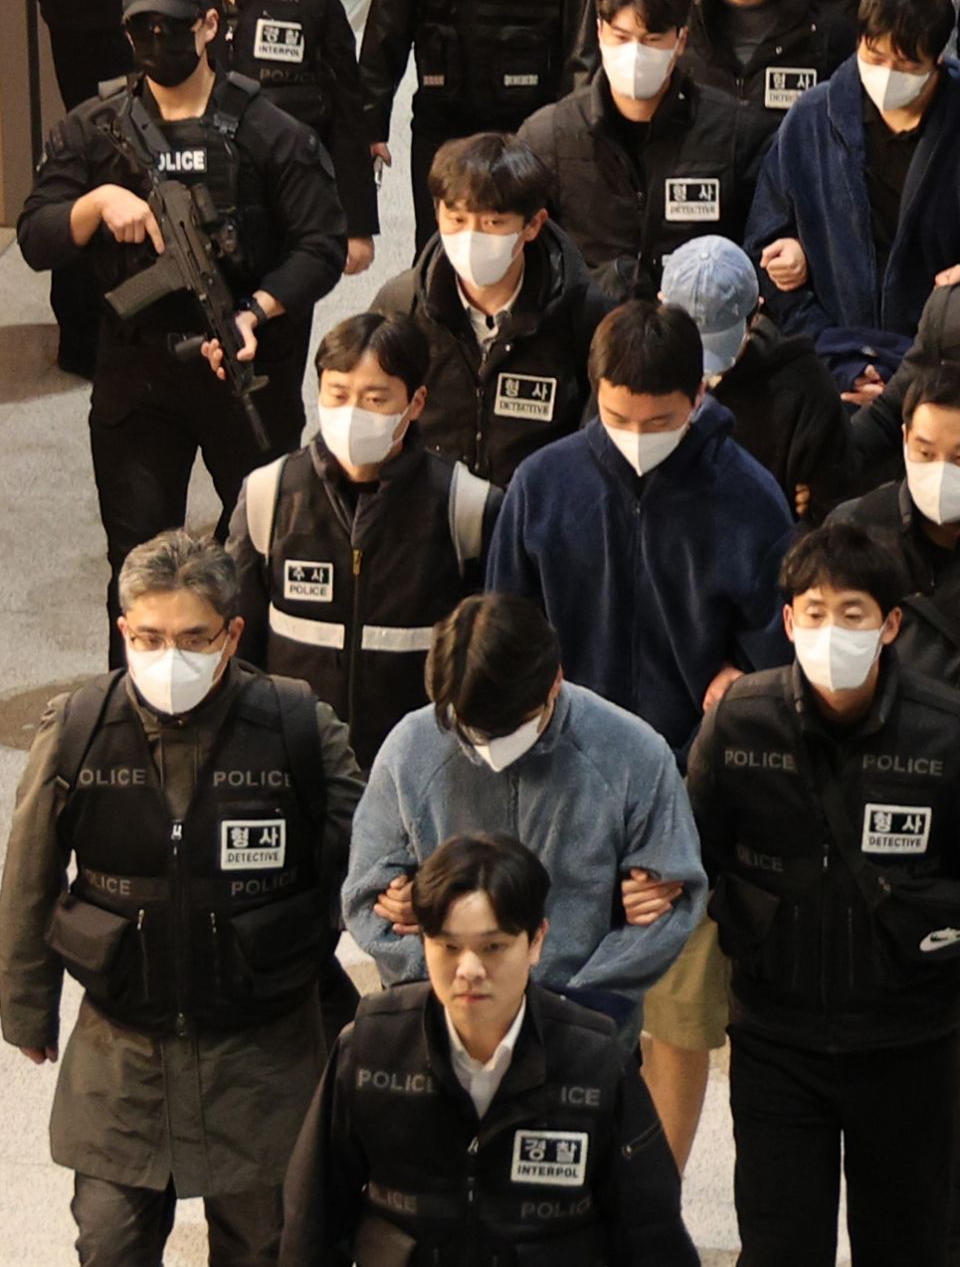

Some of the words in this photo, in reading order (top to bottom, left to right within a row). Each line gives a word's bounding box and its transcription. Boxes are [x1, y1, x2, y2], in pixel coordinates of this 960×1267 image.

[258, 44, 301, 57] INTERPOL
[669, 204, 716, 215] DETECTIVE
[499, 400, 550, 416] DETECTIVE
[289, 584, 327, 597] POLICE
[725, 750, 795, 770] POLICE
[862, 754, 944, 776] POLICE
[79, 768, 147, 786] OLICE
[869, 836, 922, 848] DETECTIVE
[227, 851, 280, 863] DETECTIVE
[517, 1164, 579, 1179] INTERPOL
